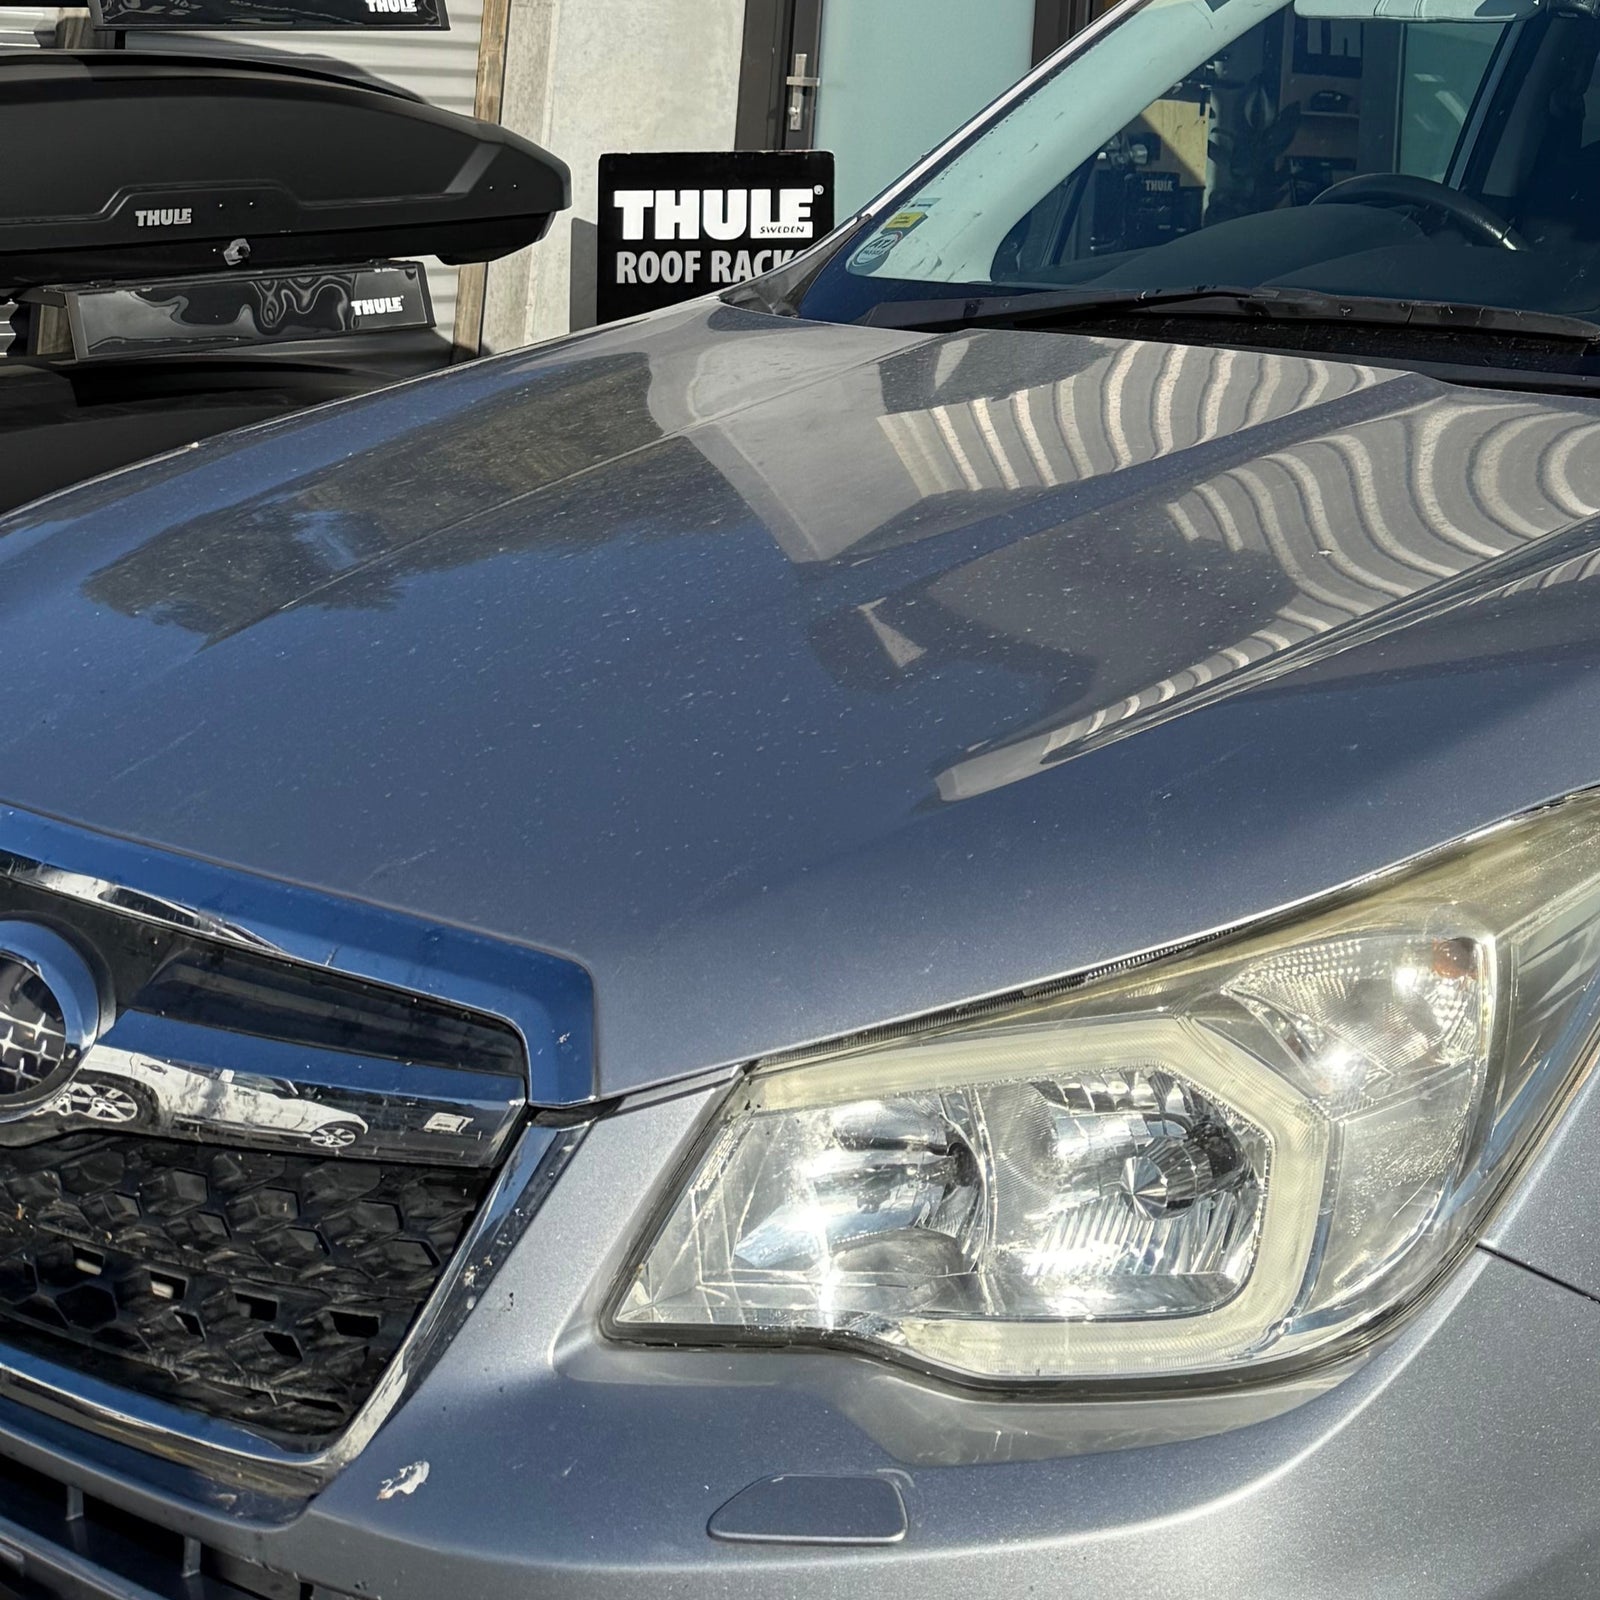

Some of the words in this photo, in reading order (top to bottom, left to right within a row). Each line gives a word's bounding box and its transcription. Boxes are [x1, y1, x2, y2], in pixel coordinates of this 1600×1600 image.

[135, 207, 192, 227] THULE
[613, 188, 814, 241] THULE
[759, 225, 806, 234] SWEDEN
[616, 250, 701, 284] ROOF
[711, 249, 806, 283] RAC
[350, 295, 404, 316] THULE
